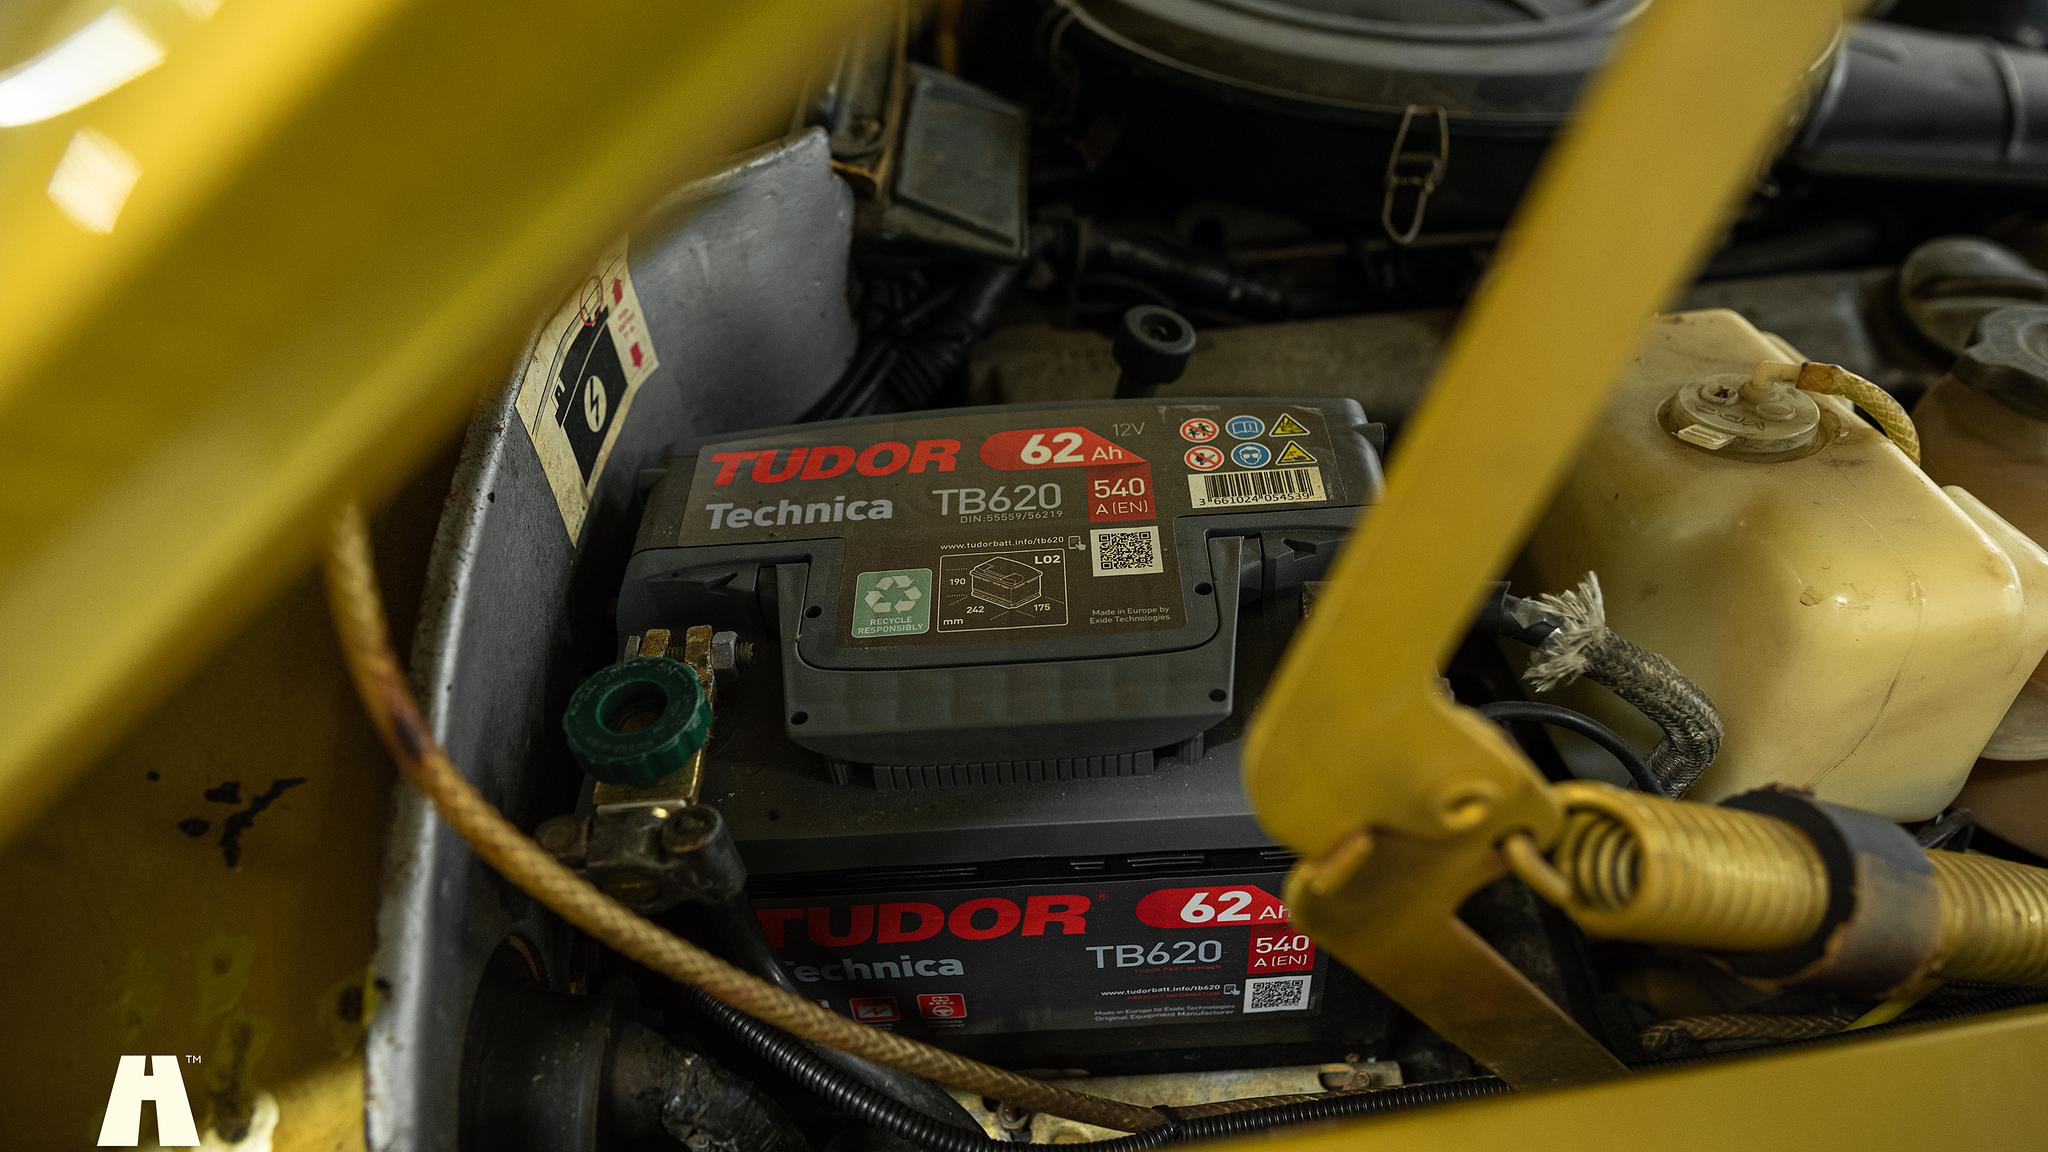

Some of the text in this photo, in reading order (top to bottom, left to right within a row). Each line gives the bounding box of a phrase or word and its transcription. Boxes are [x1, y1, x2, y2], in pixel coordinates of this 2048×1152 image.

[1112, 422, 1145, 437] 12V
[1020, 432, 1122, 465] 62 Ah
[710, 439, 961, 487] TUDOR
[1094, 477, 1145, 499] 540
[932, 483, 1062, 516] TB620
[1199, 490, 1310, 506] 3 661024 054539
[705, 495, 893, 530] Technica
[1096, 500, 1149, 515] A (EN)
[960, 511, 1063, 523] DIN:55559/56219
[940, 536, 1064, 550] www.tudorbatt.info/tb620
[966, 606, 985, 614] 242
[1117, 607, 1125, 615] in
[1127, 606, 1157, 616] Europe
[870, 616, 912, 625] RECYCLE
[1089, 613, 1170, 624] Exide Technologies
[857, 624, 924, 635] RESPONSIBLY
[1180, 890, 1253, 924] 62
[754, 894, 1092, 950] TUDOR
[1256, 935, 1310, 954] 540
[1086, 940, 1223, 969] TB620
[1254, 954, 1308, 967] A (EN)
[784, 954, 964, 983] echnica
[1101, 984, 1221, 996] www.tudorbatt.info/tb620
[1094, 1009, 1235, 1022] Original Equipment Manufacturer
